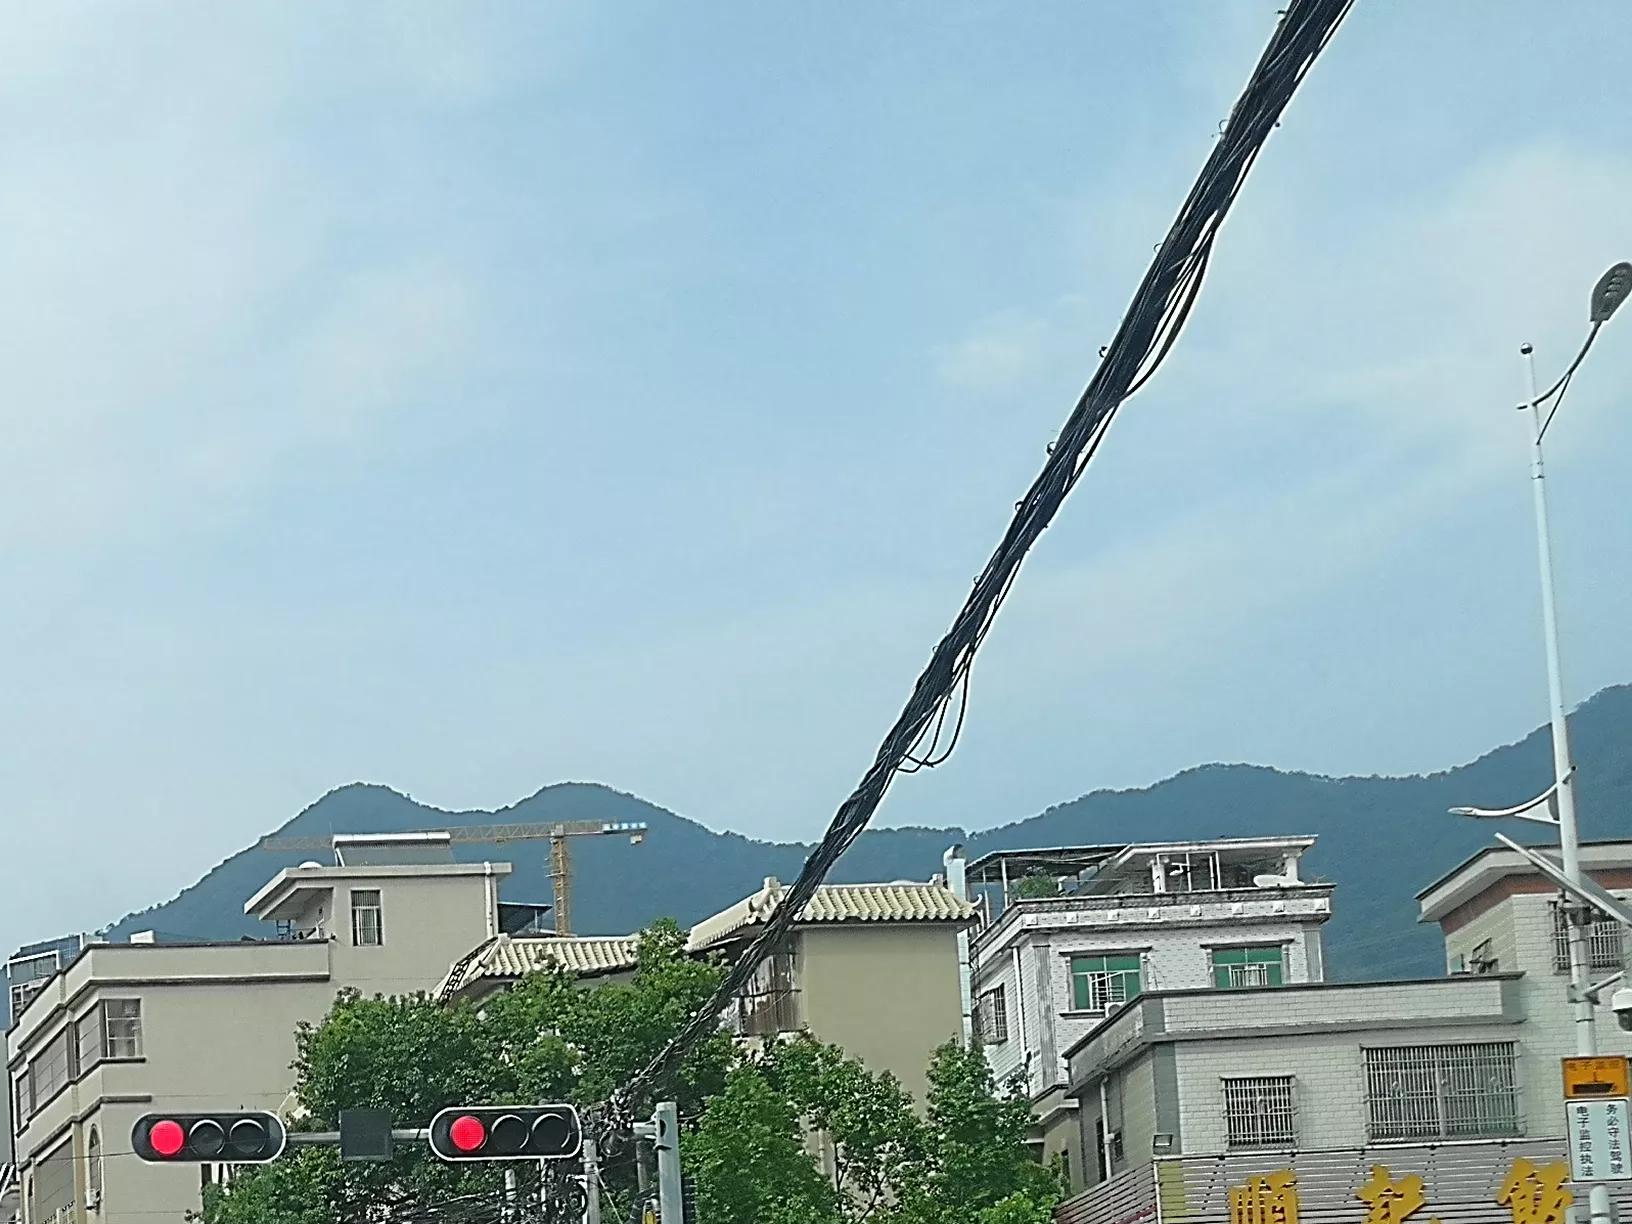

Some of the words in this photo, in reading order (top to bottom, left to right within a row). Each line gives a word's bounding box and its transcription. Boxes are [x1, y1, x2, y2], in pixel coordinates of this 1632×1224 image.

[1576, 1105, 1594, 1177] 电子监控执法
[1606, 1103, 1624, 1175] 务必守法驾驶
